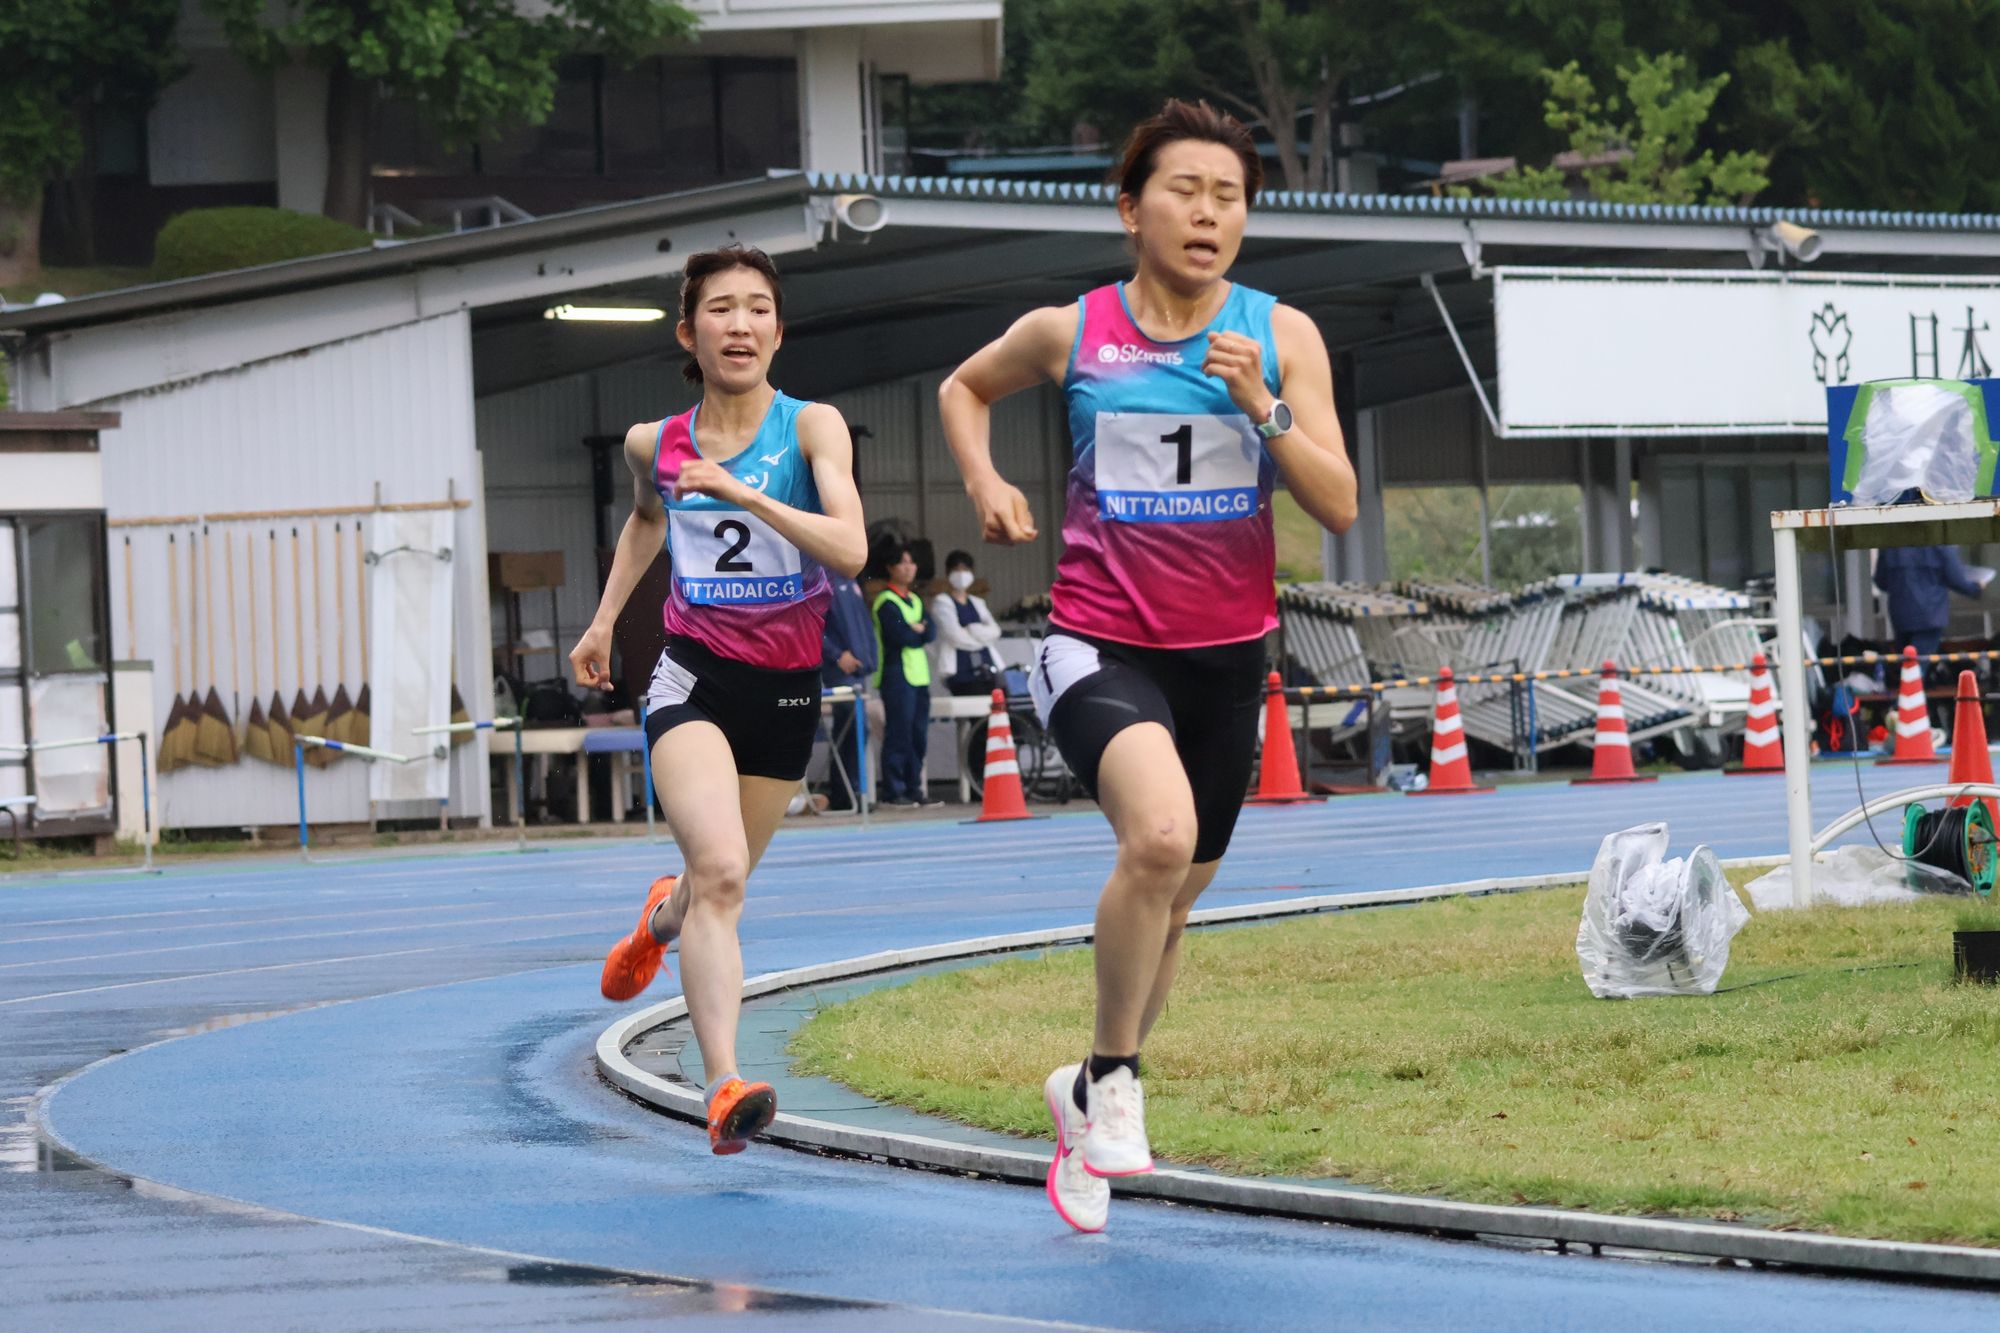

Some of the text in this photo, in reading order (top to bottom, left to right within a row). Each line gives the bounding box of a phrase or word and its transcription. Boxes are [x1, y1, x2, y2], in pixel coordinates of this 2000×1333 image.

[1160, 425, 1192, 484] 1
[1106, 495, 1211, 516] NITTAIDAI
[714, 519, 753, 572] 2
[778, 696, 810, 707] 2XU
